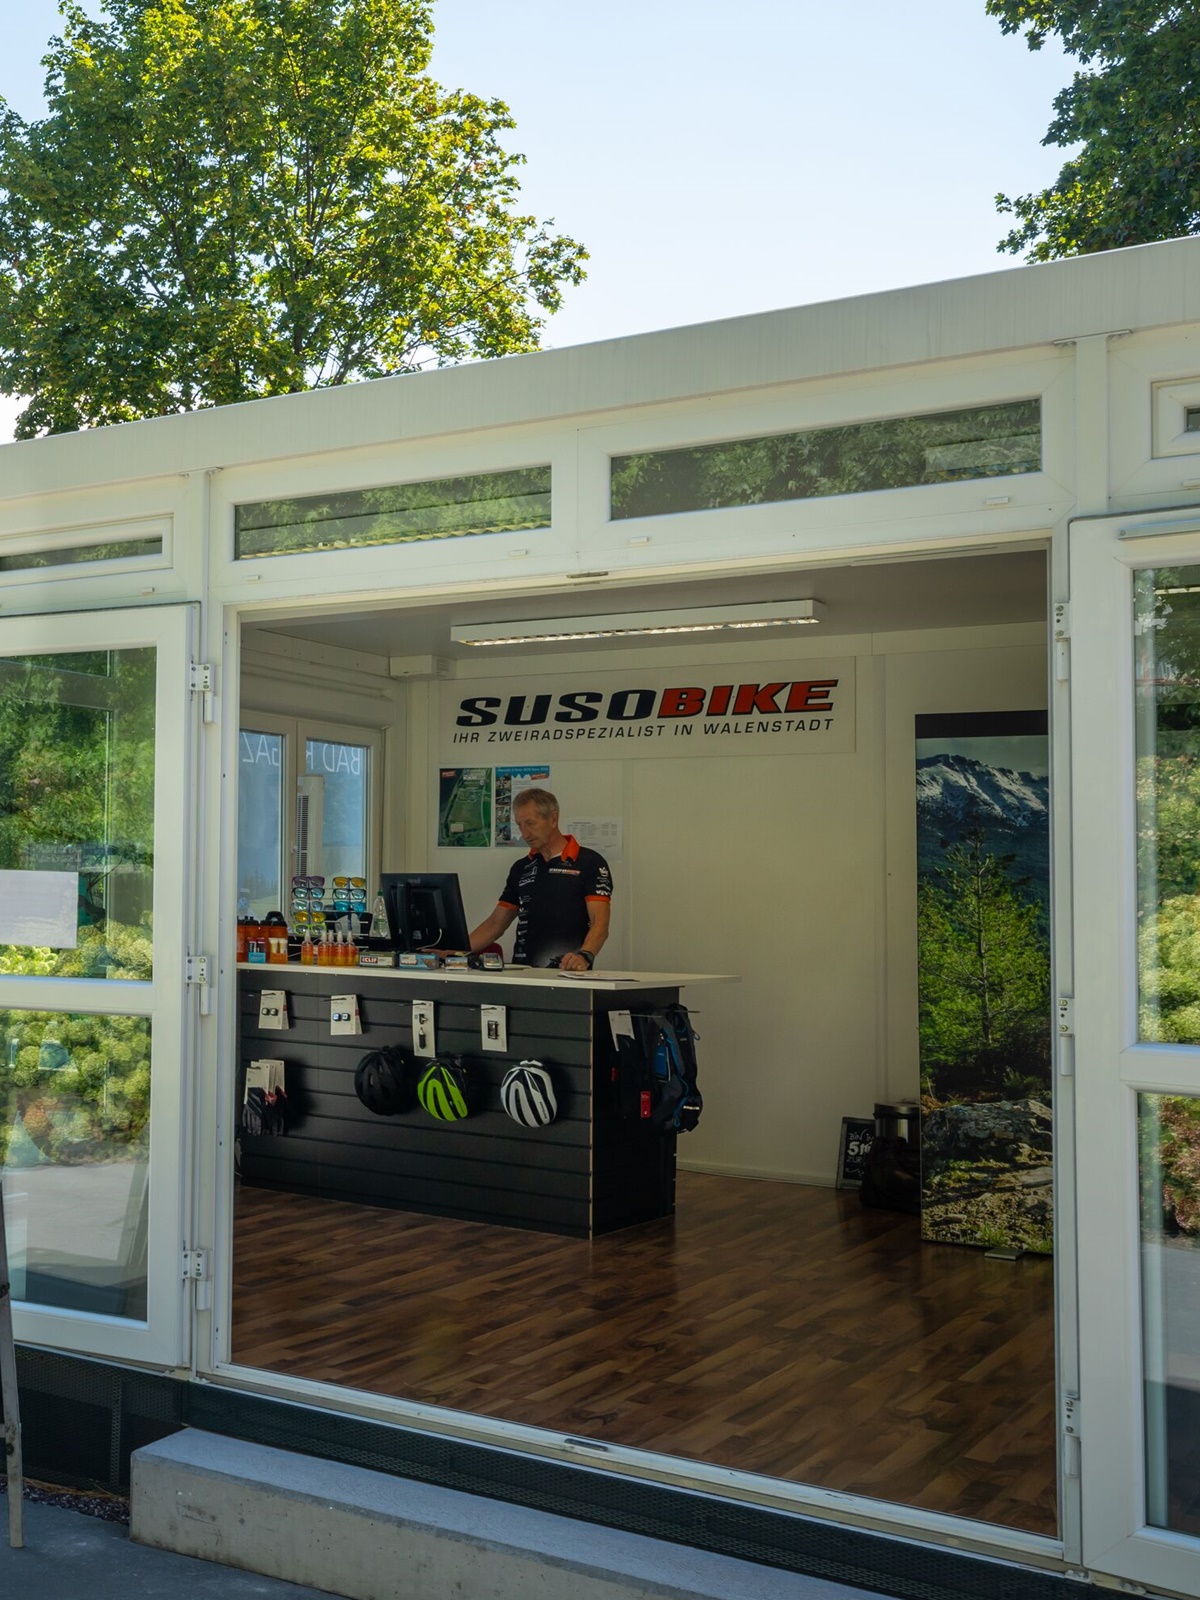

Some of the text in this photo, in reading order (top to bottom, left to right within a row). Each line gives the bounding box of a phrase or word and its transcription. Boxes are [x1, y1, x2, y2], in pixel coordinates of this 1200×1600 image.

[455, 679, 839, 727] SUSOBIKE
[452, 718, 835, 744] IHR ZWEIRADSPEZIALIST IN WALENSTADT
